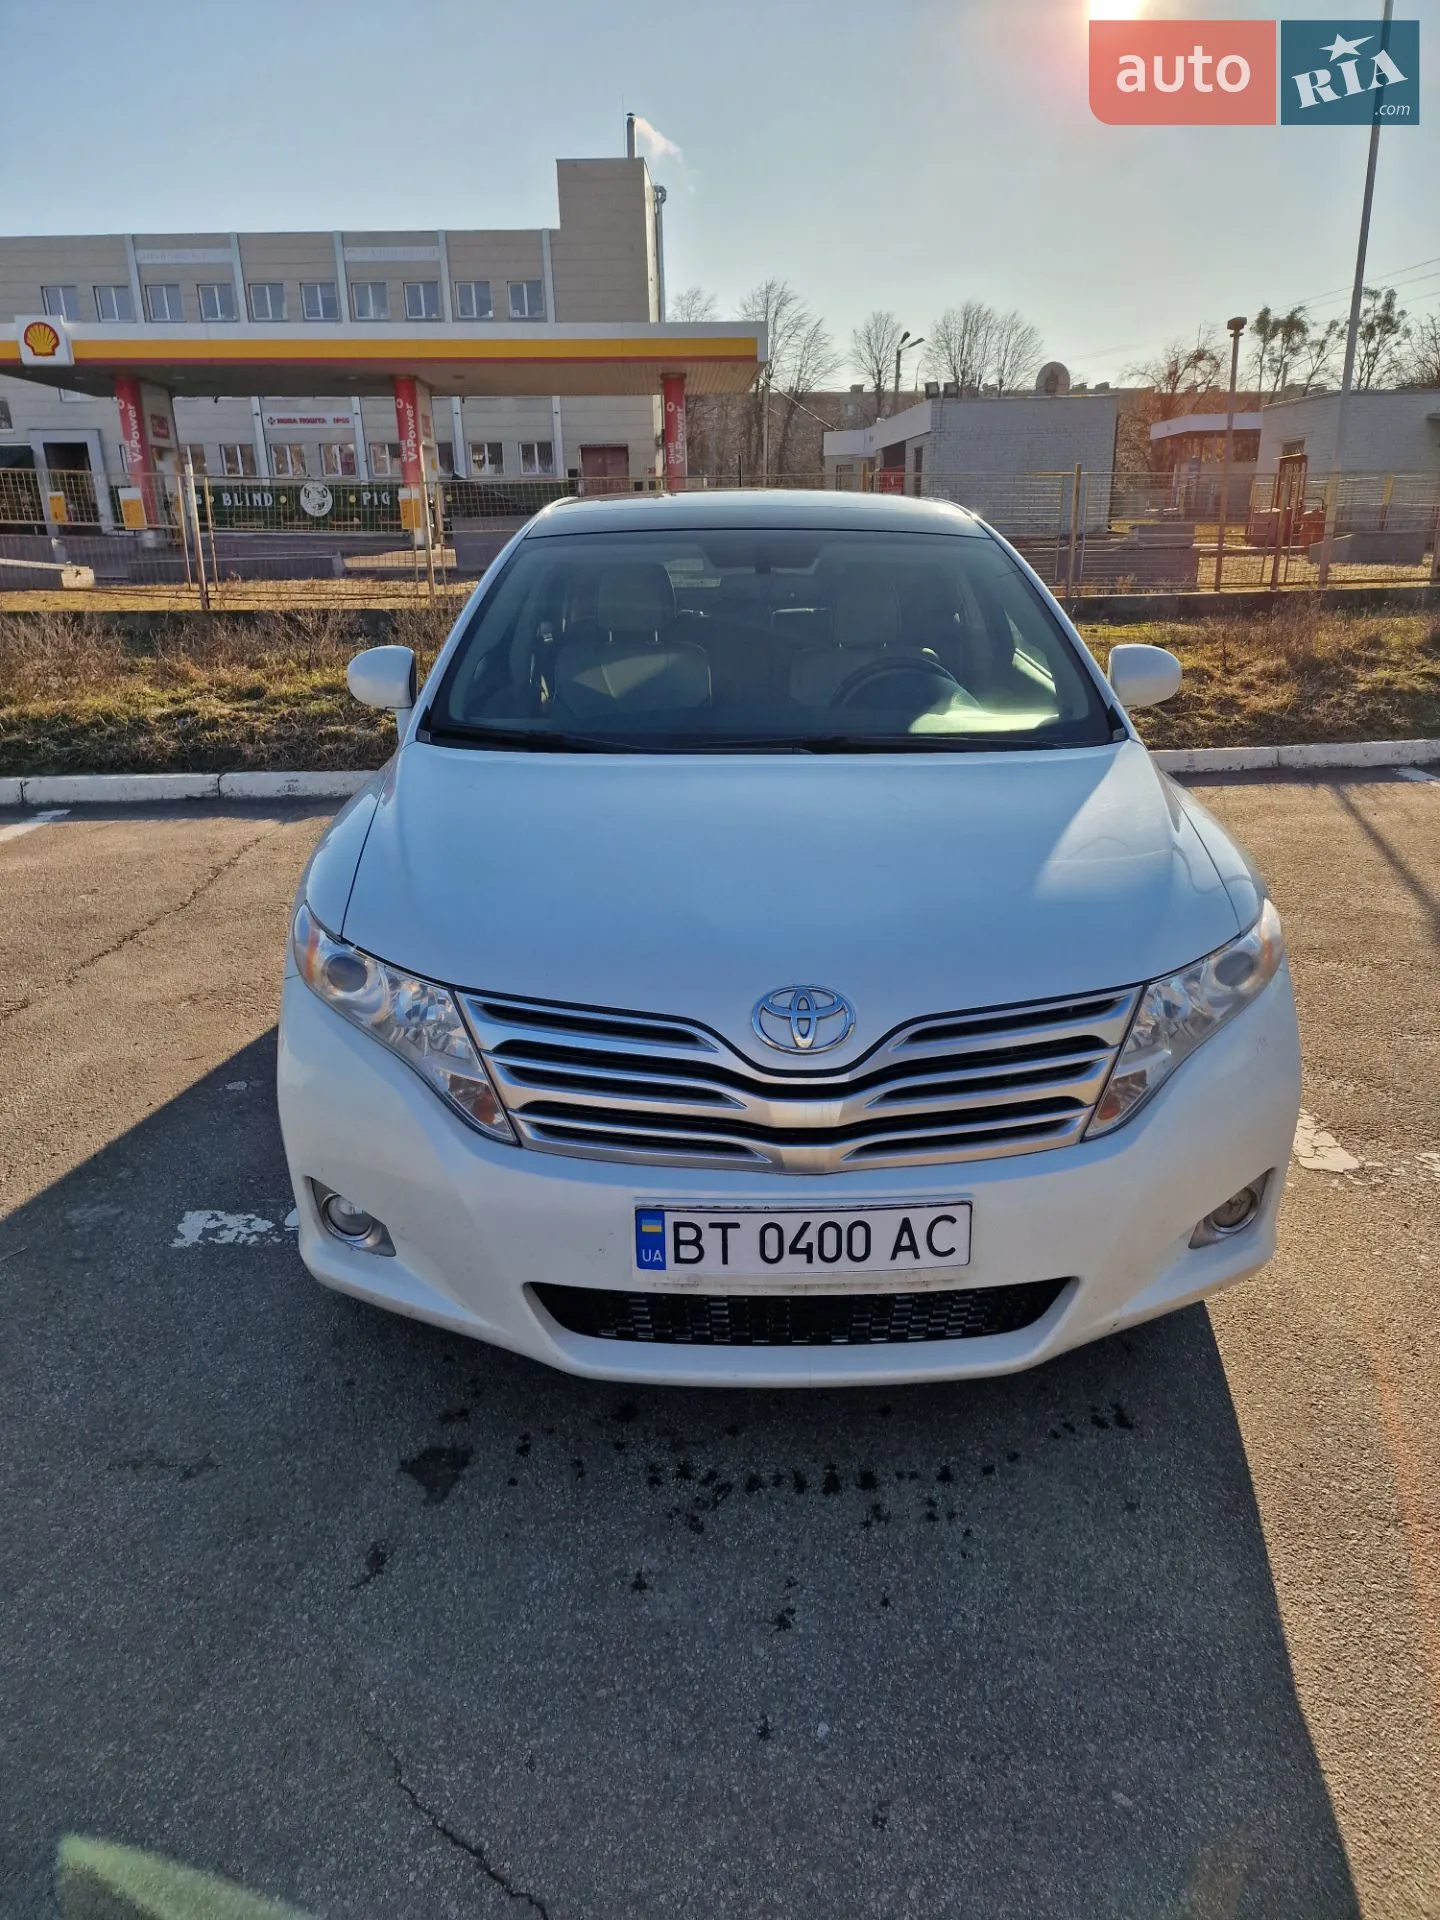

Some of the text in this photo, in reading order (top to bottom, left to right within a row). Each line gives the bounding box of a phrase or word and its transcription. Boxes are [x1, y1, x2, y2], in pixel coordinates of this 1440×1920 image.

[406, 402, 418, 462] V-Power
[221, 492, 274, 507] BLIND
[362, 491, 391, 507] PIG
[641, 1214, 958, 1265] UA BT 0400 AC
